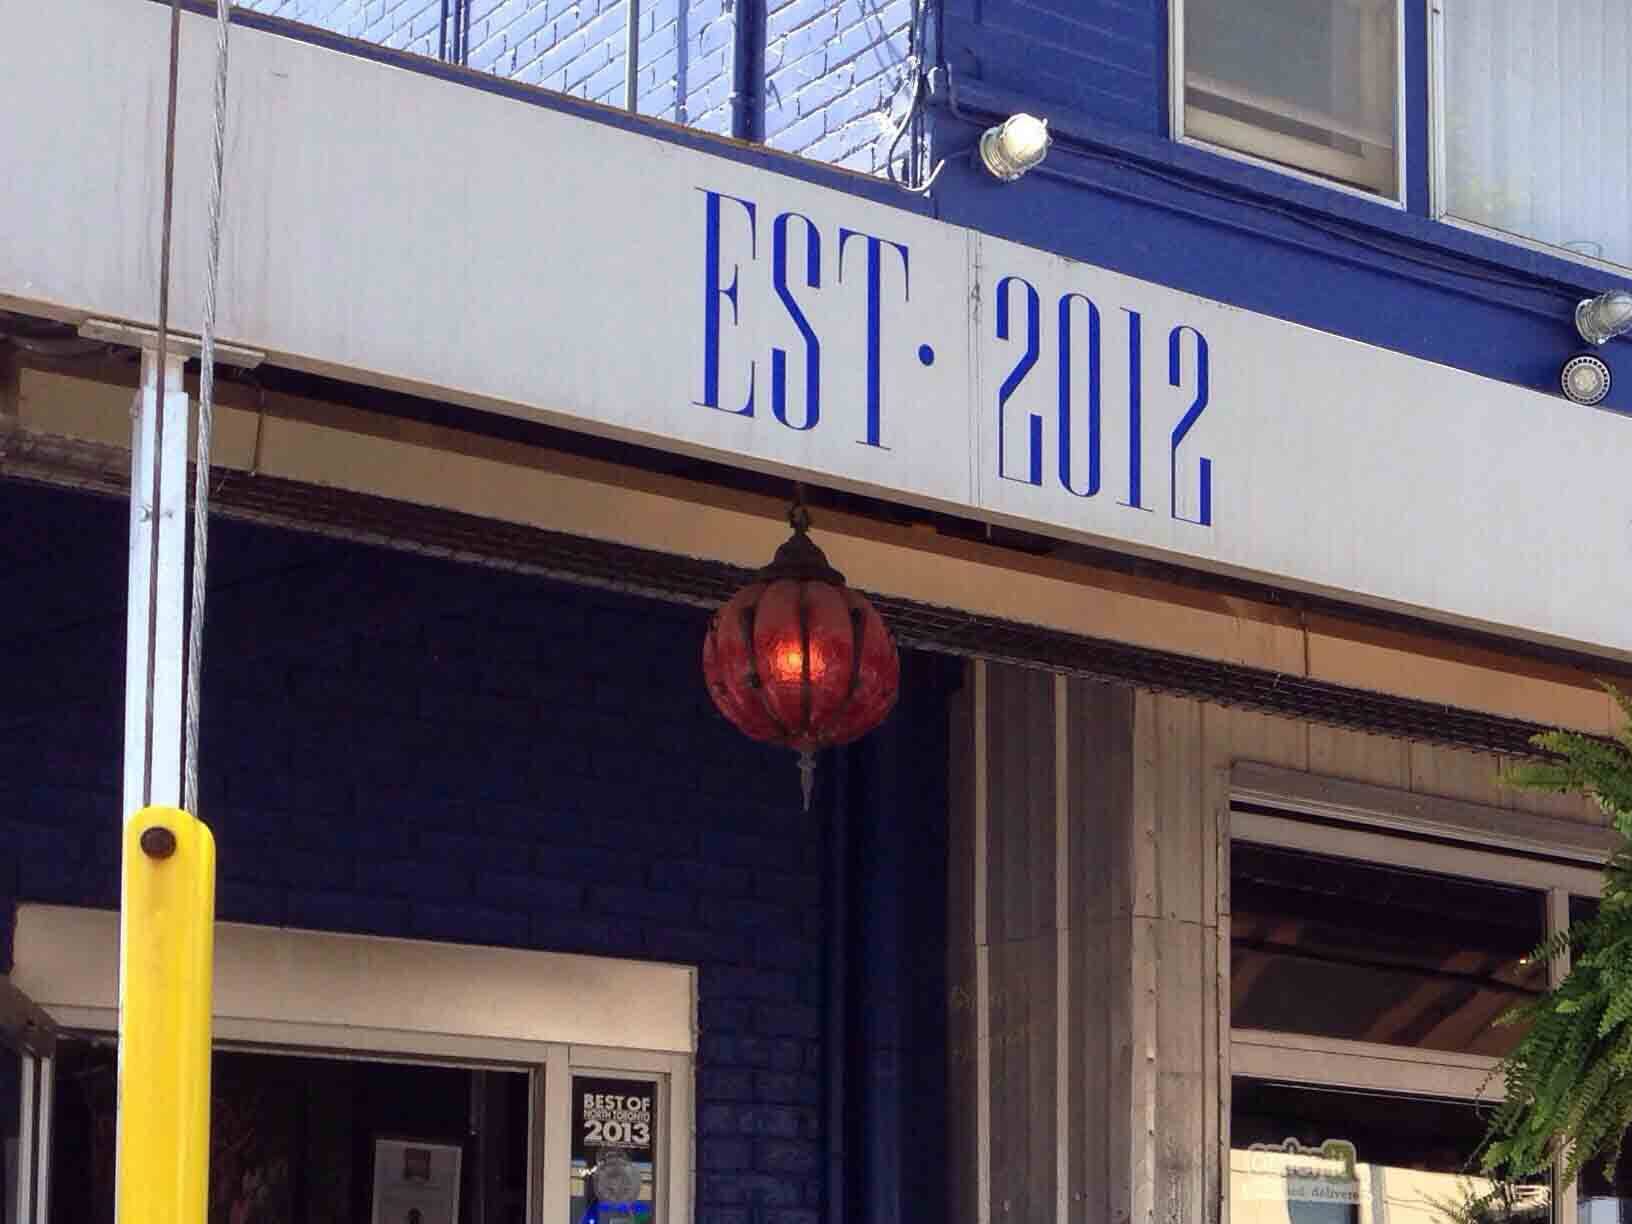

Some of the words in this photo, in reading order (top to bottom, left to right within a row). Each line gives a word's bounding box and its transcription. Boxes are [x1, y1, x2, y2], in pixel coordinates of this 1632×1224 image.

[995, 275, 1212, 527] 2012
[584, 1093, 625, 1110] BEST
[627, 1096, 650, 1112] OF
[584, 1120, 650, 1144] 2013
